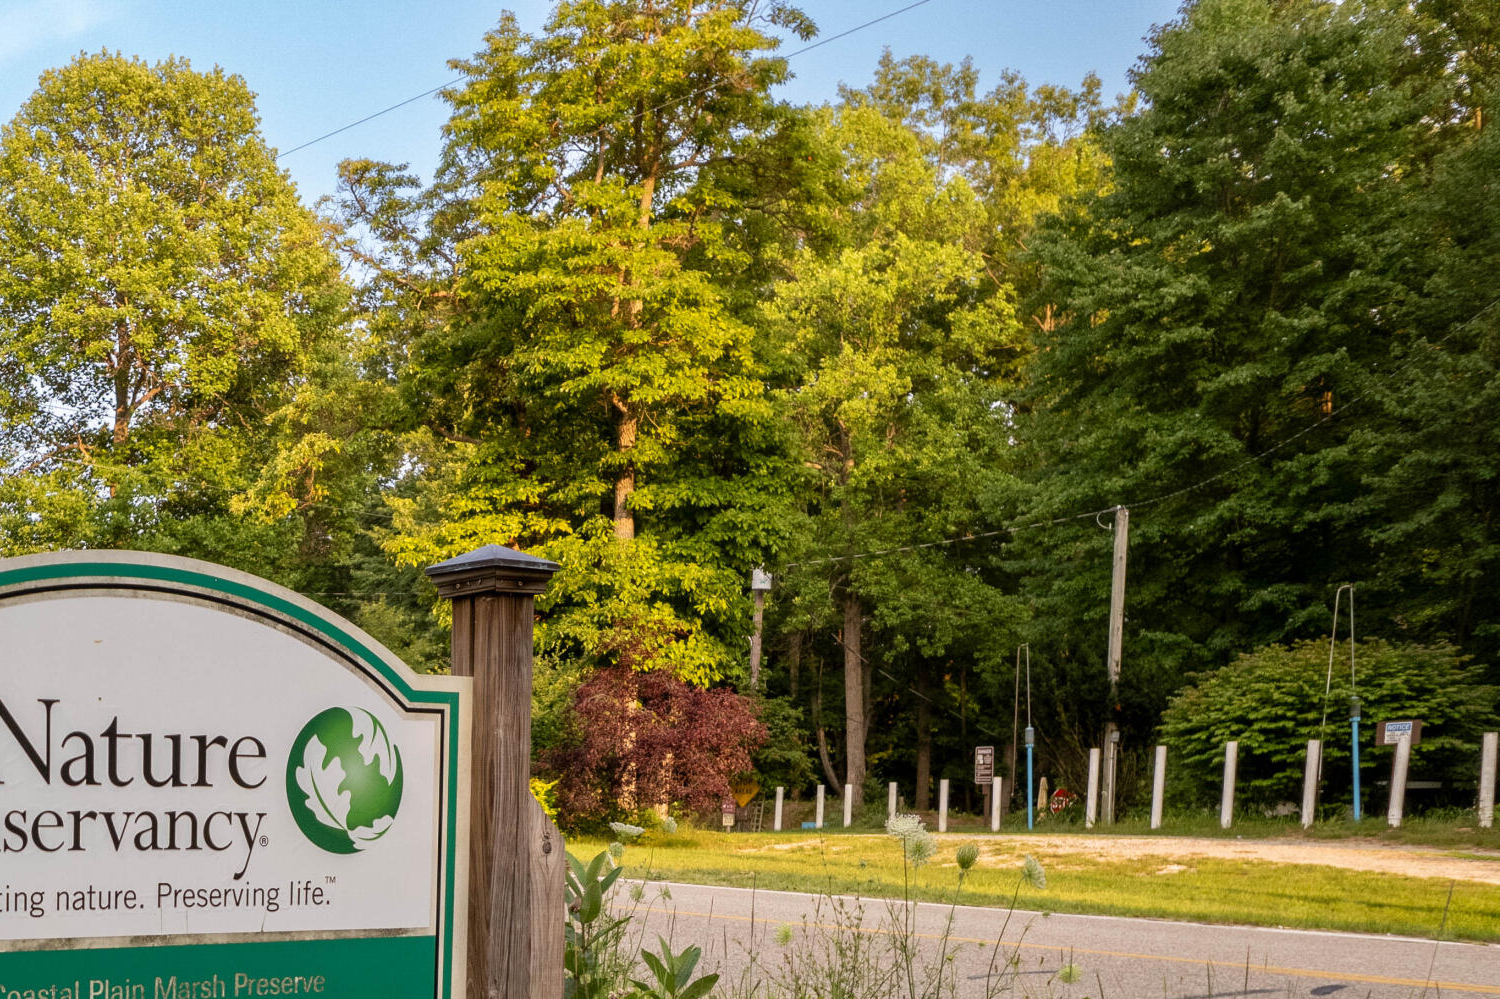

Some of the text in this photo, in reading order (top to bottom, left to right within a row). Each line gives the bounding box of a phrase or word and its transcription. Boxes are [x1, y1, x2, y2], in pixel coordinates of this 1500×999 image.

[56, 884, 145, 911] nature.
[157, 881, 280, 912] Preserving
[234, 972, 326, 997] Preserve
